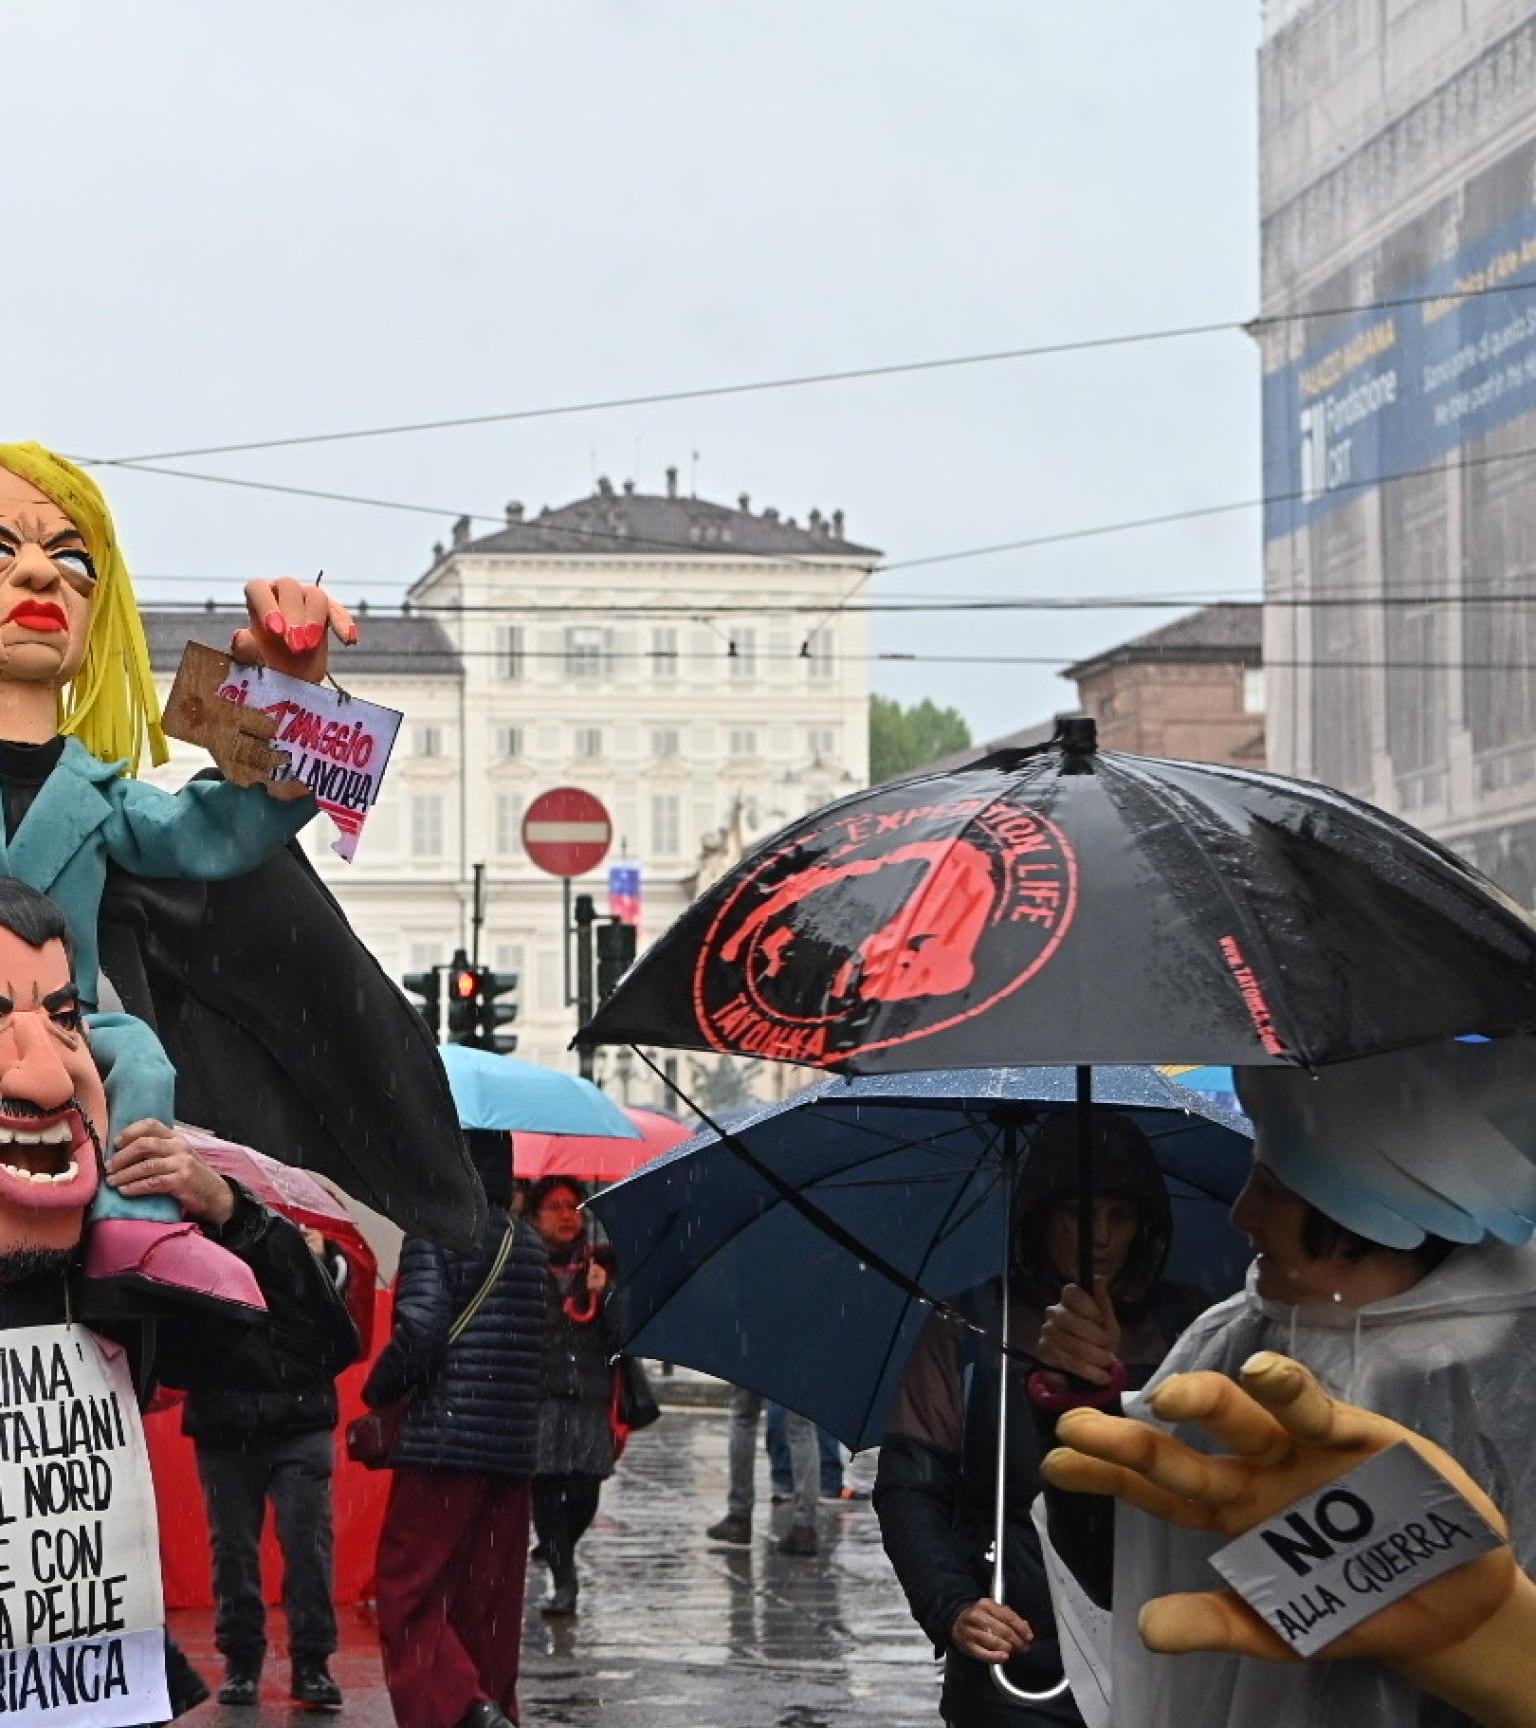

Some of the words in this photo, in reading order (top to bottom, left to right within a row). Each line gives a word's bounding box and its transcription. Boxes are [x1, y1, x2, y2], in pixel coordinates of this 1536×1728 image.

[1010, 863, 1061, 929] LIFE
[24, 1455, 114, 1518] NORD
[31, 1520, 102, 1584] CON
[1260, 1489, 1374, 1577] NO
[26, 1574, 128, 1644] PELLE
[1276, 1585, 1347, 1640] ALLA
[1342, 1512, 1473, 1594] GUERRA
